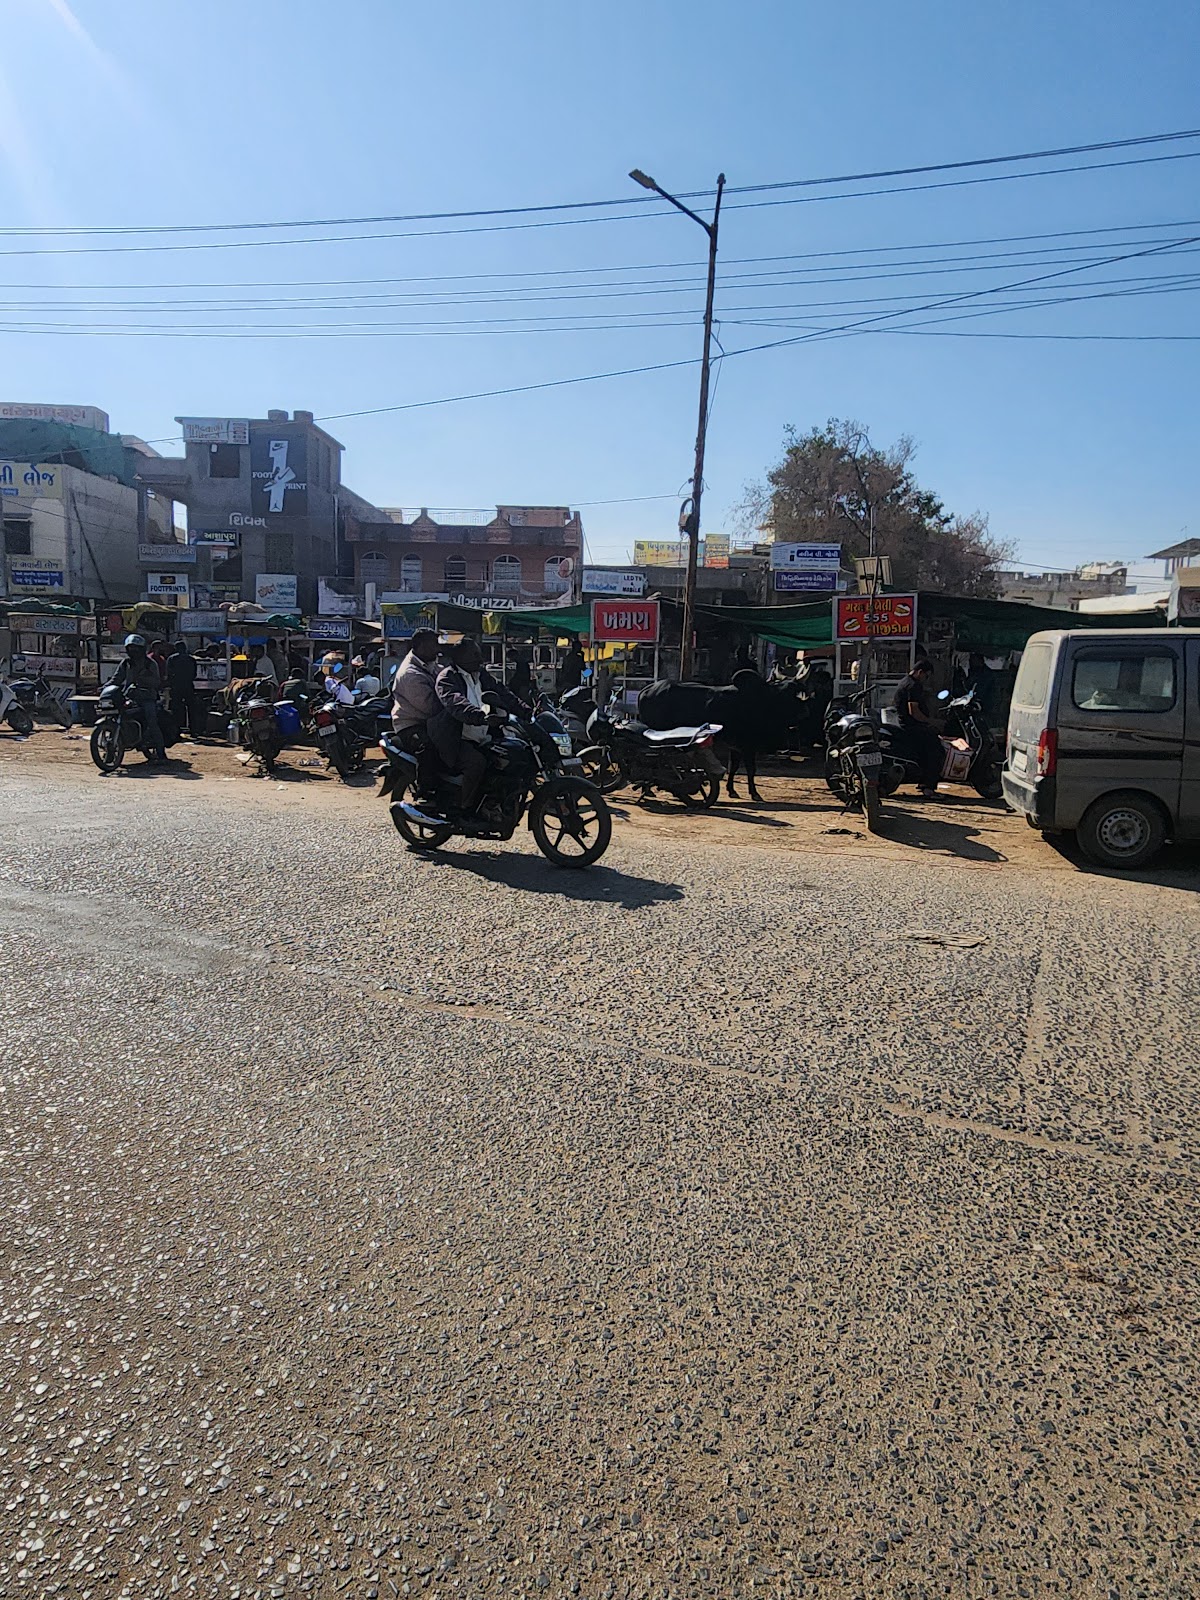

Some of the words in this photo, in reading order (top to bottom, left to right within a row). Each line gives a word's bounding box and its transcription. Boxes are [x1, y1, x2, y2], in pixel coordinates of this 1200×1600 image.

[24, 464, 56, 487] લોજ
[252, 471, 274, 479] FOOT
[150, 585, 187, 593] FOOTPRINTS
[481, 597, 515, 611] PIZZA
[866, 598, 892, 613] દબેલી
[602, 611, 649, 630] ખમણ
